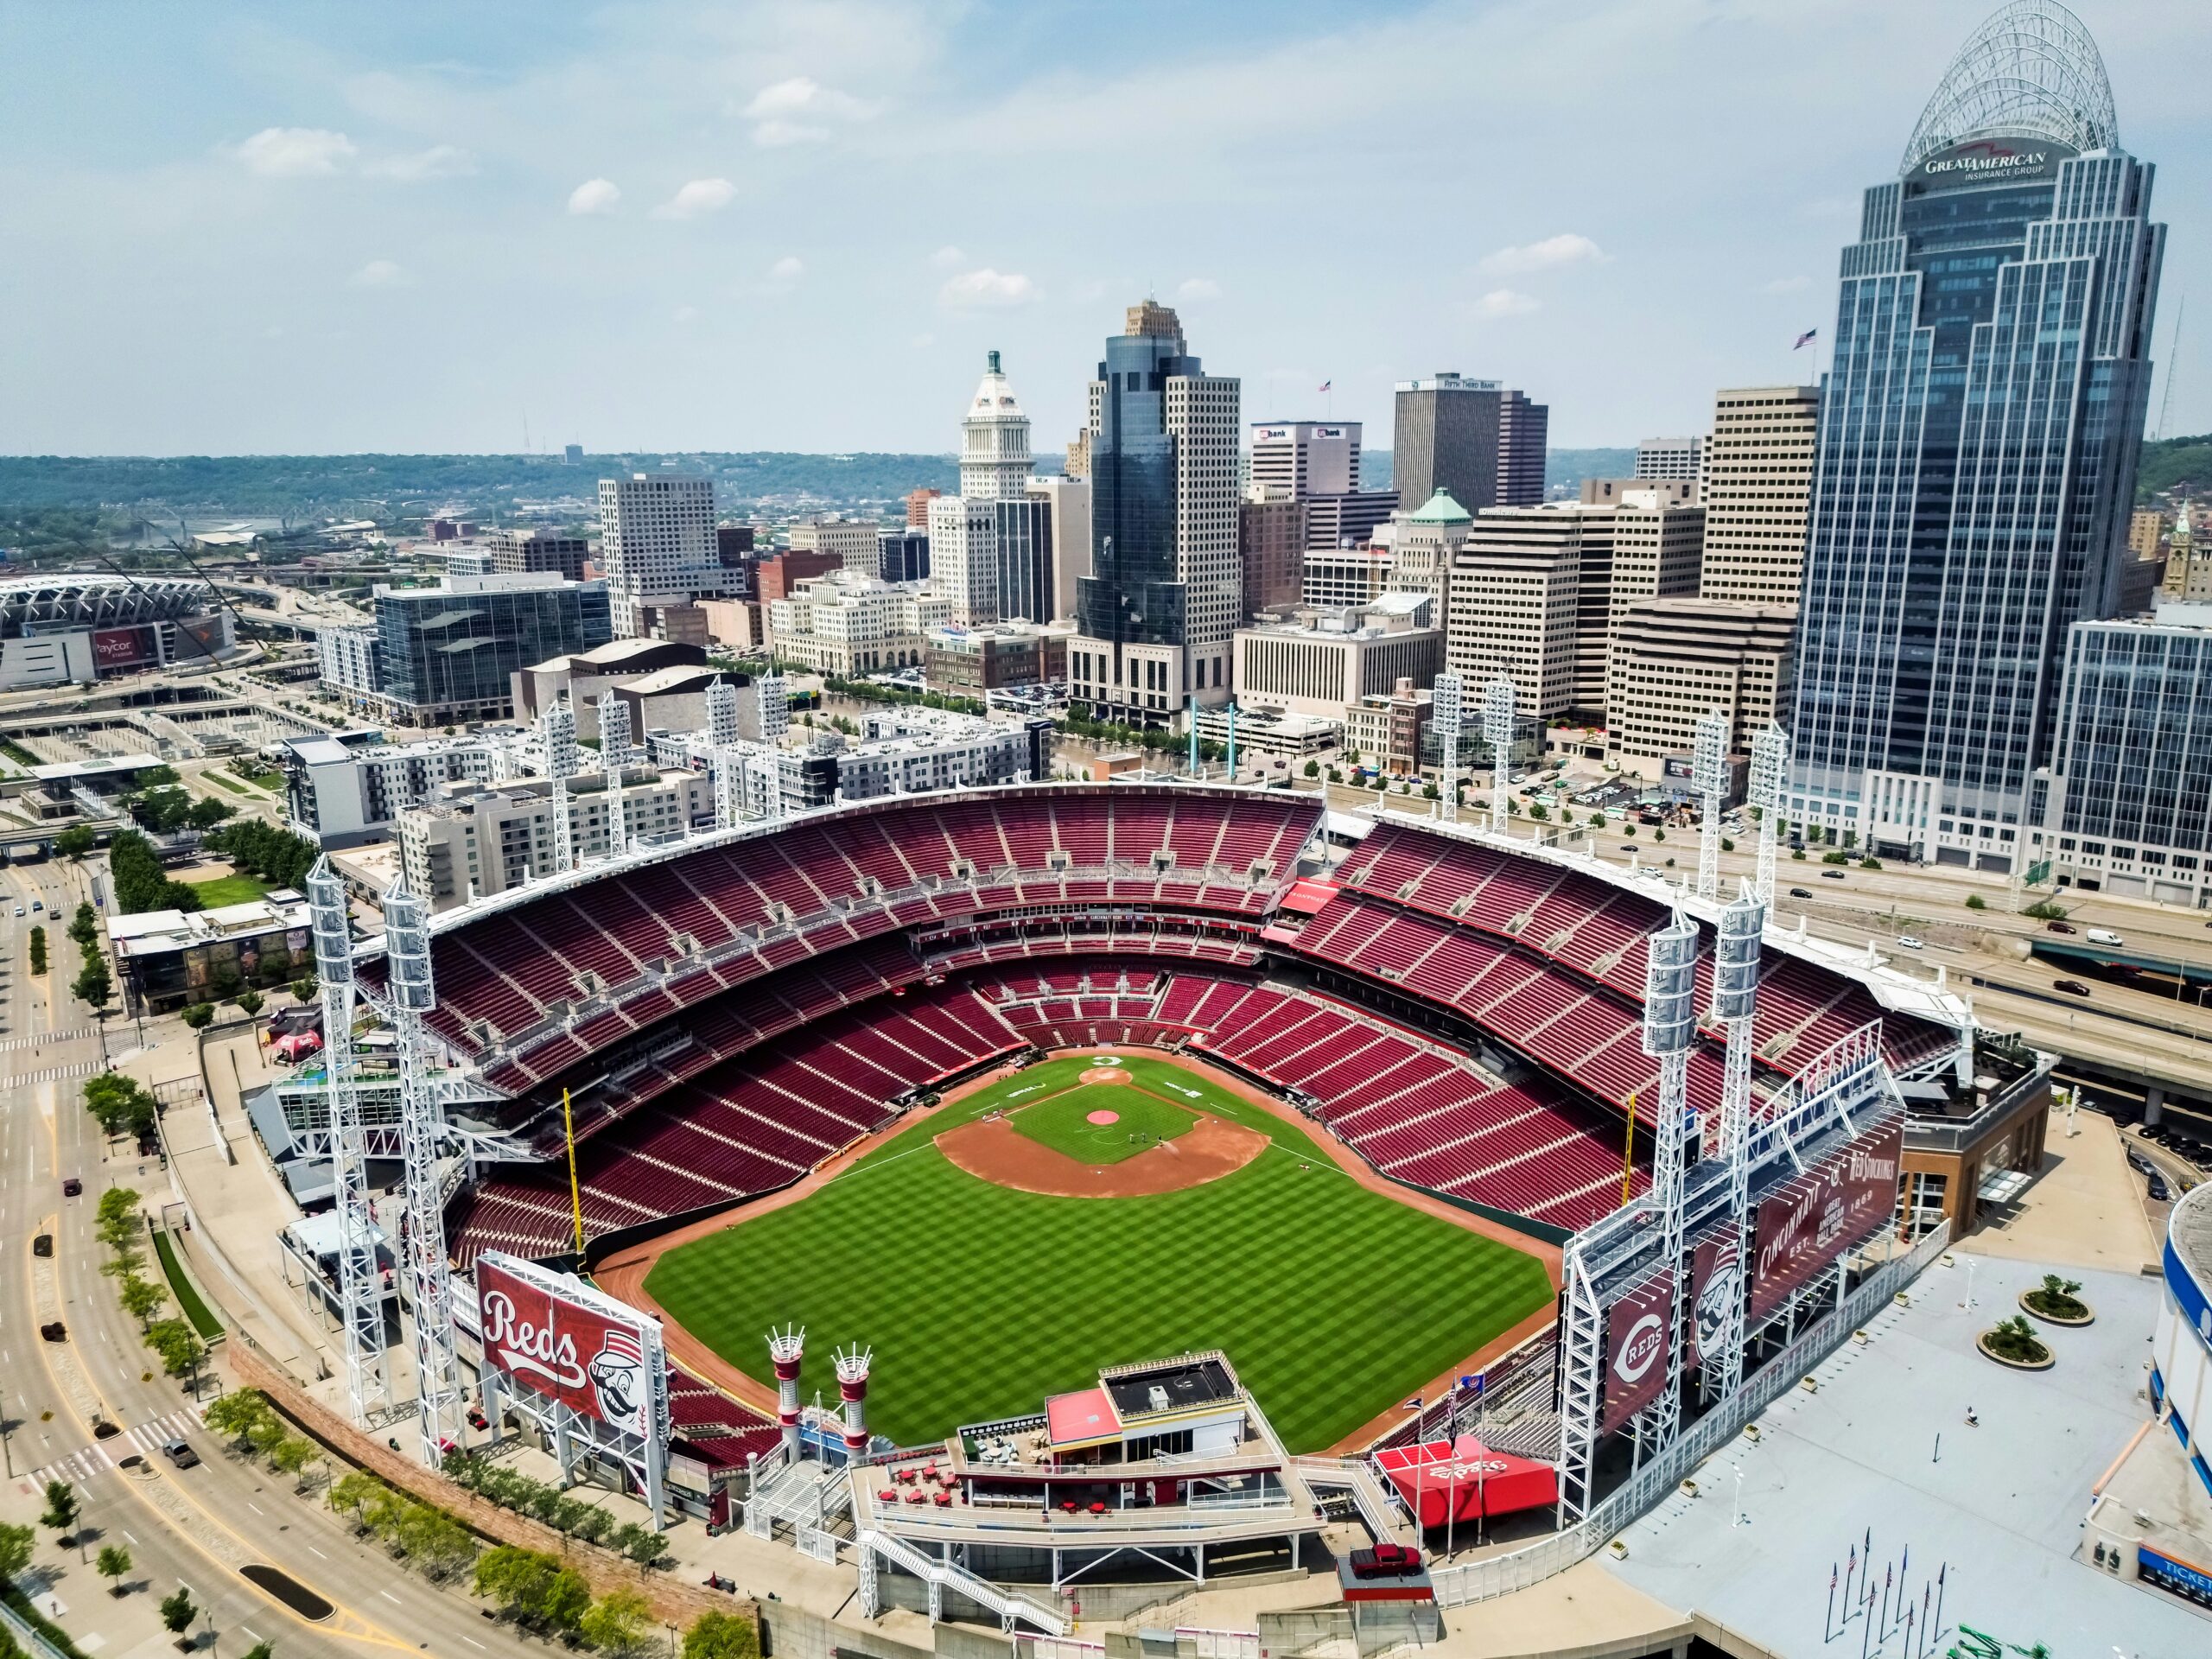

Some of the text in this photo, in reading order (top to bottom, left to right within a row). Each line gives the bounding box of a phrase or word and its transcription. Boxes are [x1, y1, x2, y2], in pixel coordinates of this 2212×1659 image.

[1965, 165, 2044, 181] INSURANCE GROUP
[1824, 1197, 1841, 1217] GREAT
[1851, 1190, 1872, 1213] 1869
[1818, 1205, 1844, 1232] AMERICAN
[484, 1290, 586, 1382] Reds
[1628, 1326, 1662, 1364] REDS
